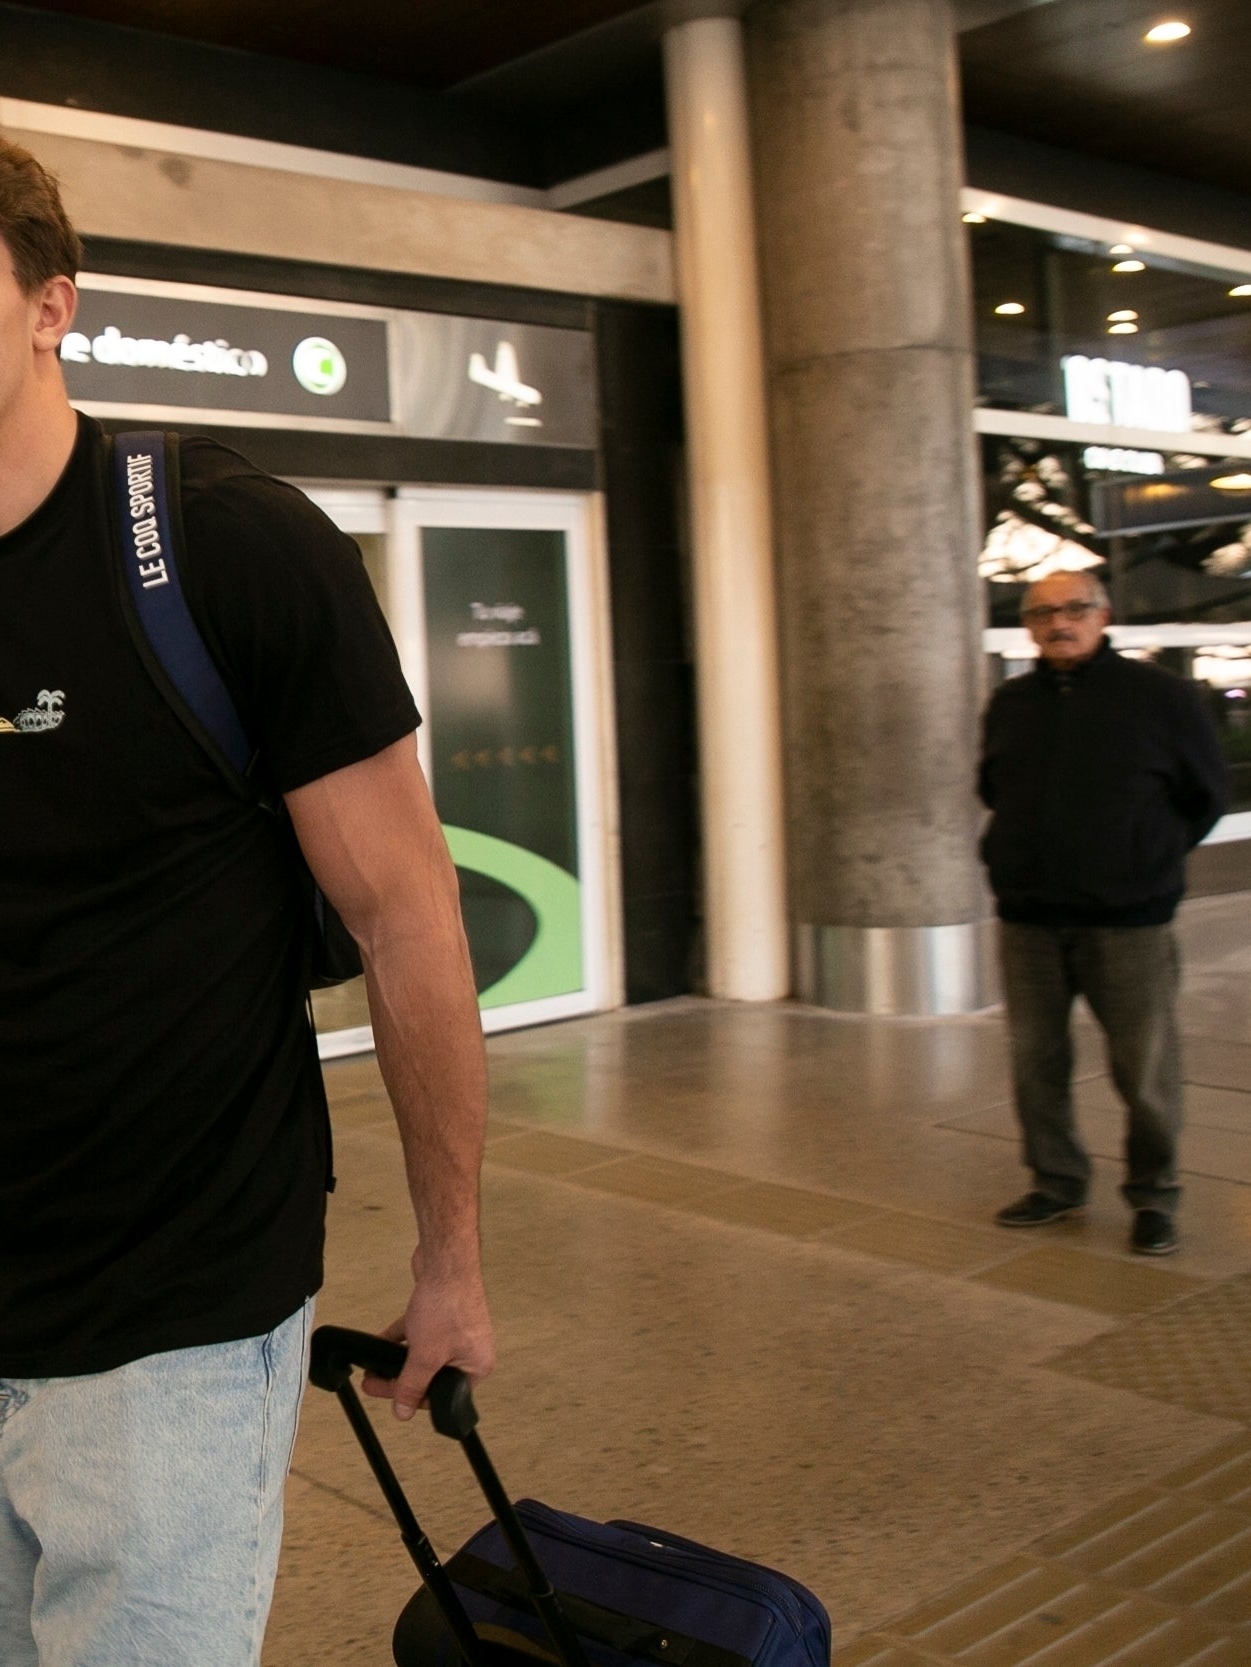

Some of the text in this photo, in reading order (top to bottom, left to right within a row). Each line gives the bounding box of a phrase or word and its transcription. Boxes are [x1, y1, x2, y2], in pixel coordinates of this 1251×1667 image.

[126, 453, 170, 590] LE COQ SPORTIF
